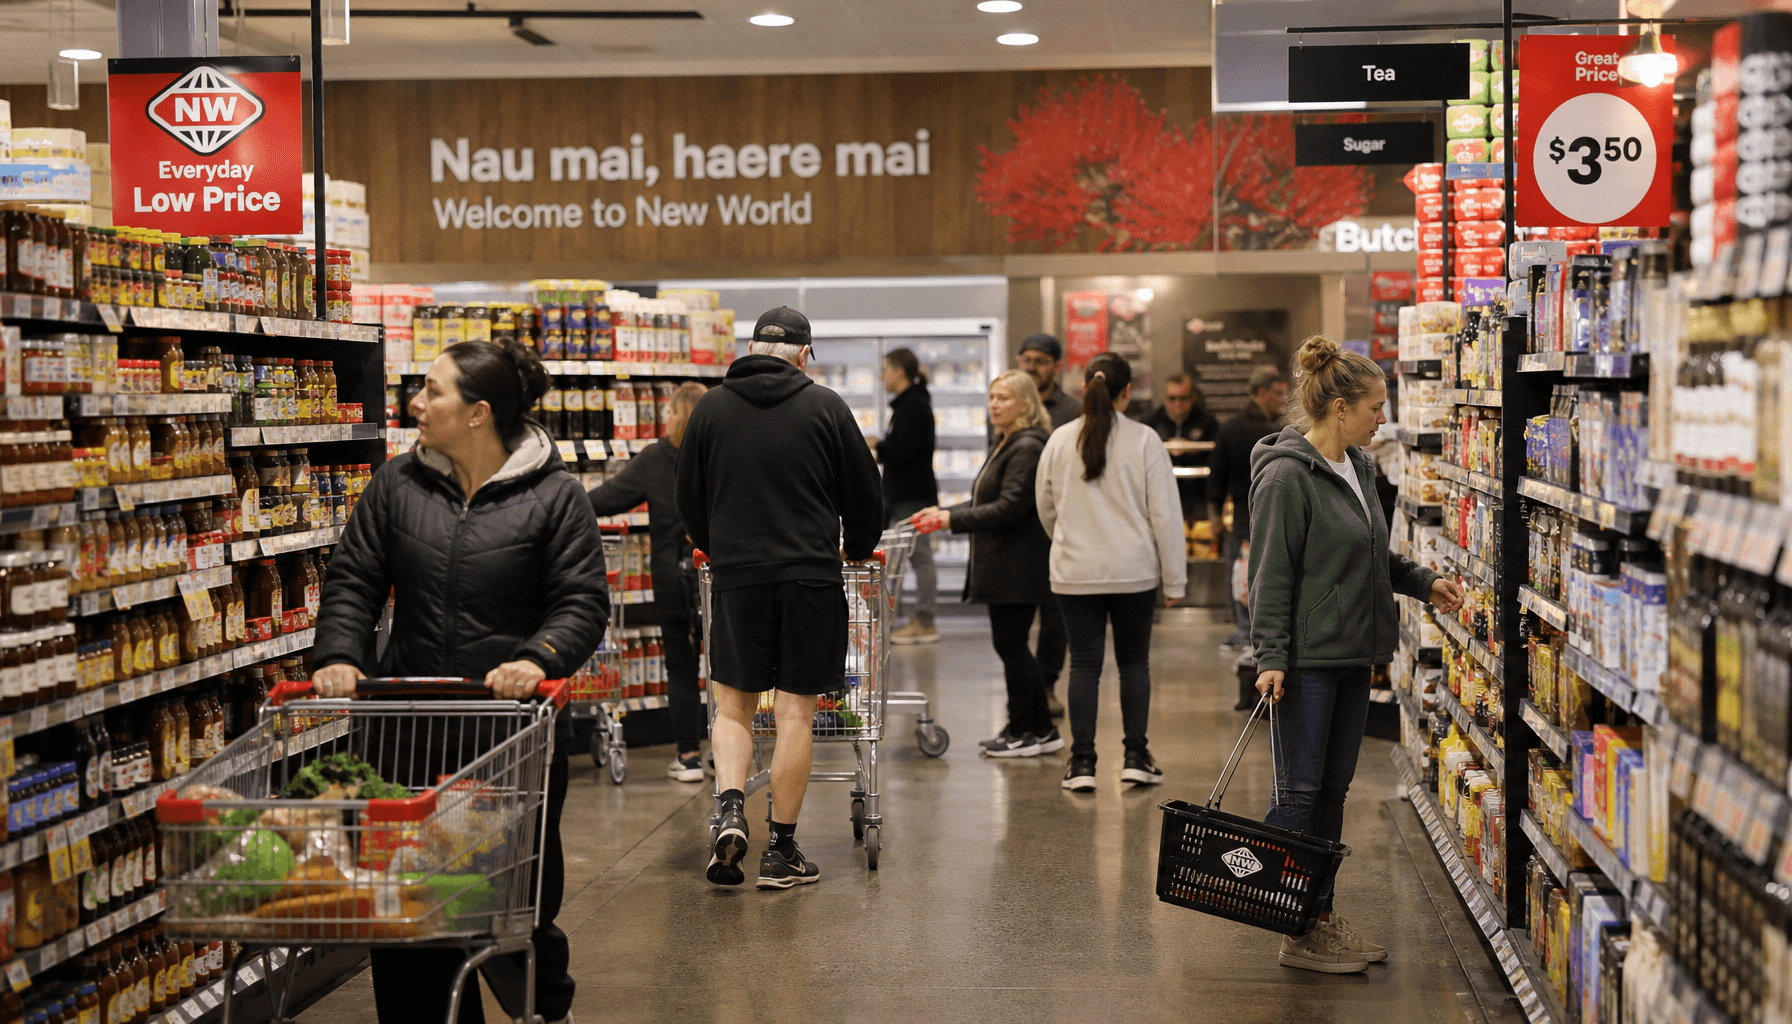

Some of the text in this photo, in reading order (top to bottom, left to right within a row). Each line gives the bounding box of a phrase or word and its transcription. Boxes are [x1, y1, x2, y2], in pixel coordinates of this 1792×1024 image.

[1575, 51, 1620, 66] Great
[1362, 65, 1396, 81] Tea
[1575, 66, 1618, 82] Price
[174, 96, 238, 123] NW
[1343, 137, 1386, 154] Sugar
[431, 129, 931, 187] Nau mai, haere mai
[158, 159, 255, 183] Everyday
[134, 184, 281, 213] Low Price
[433, 191, 813, 230] Welcome to New World
[1231, 855, 1255, 870] NW
